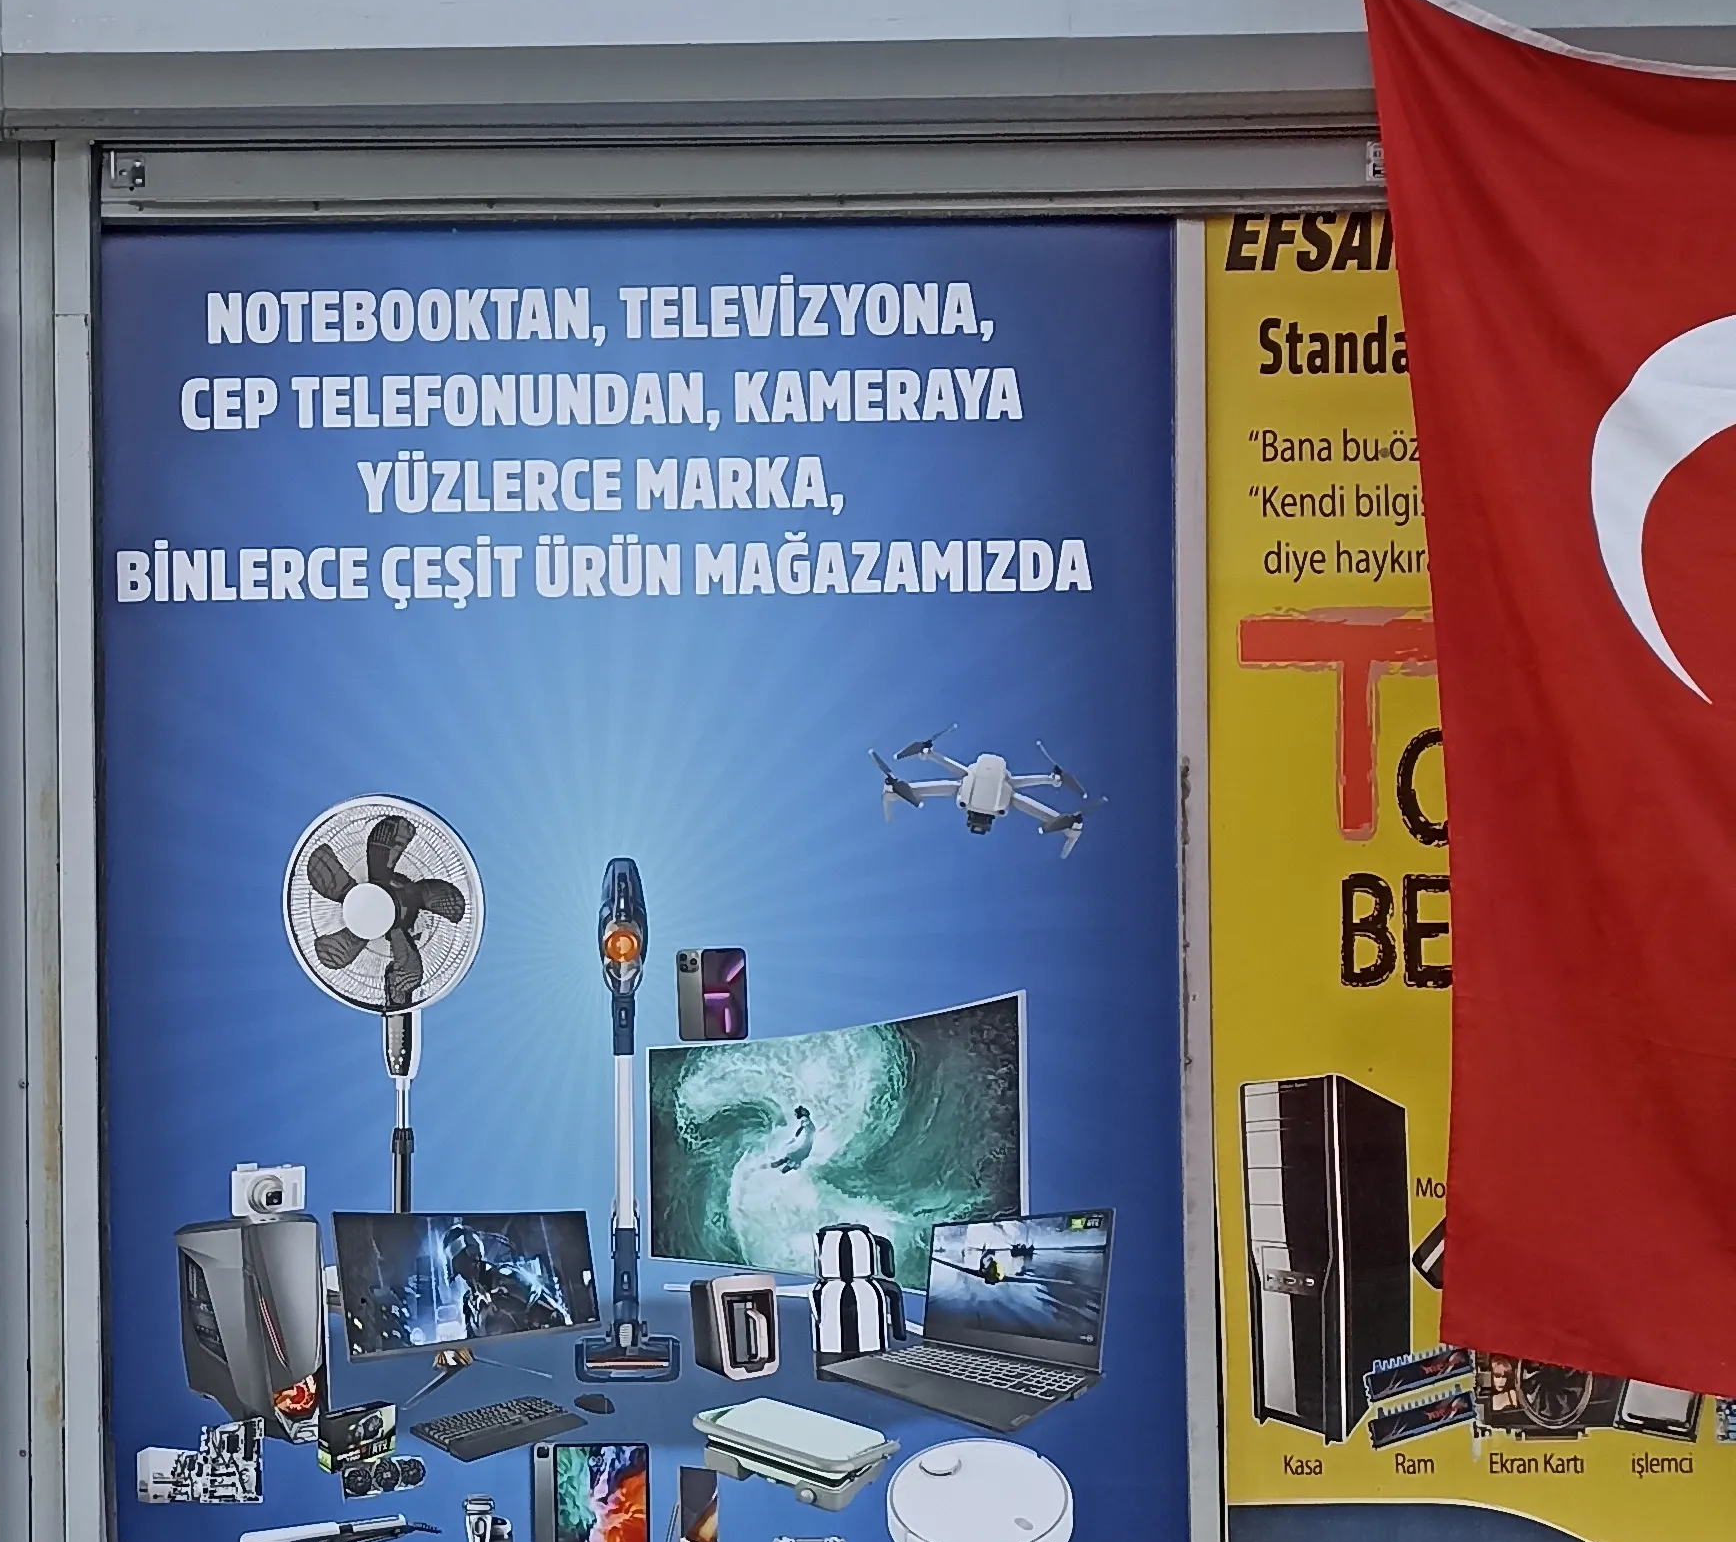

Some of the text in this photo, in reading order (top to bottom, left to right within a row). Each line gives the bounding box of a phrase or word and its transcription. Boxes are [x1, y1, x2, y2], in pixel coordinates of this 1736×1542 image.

[206, 274, 995, 348] NOTEBOOKTAN, TELEVİZYONA,
[180, 367, 1023, 431] CEP TELEFONUNDAN, KAMERAYA
[1343, 428, 1379, 462] bu
[357, 450, 844, 516] YÜZLERCE MARKA,
[1356, 483, 1424, 526] bilgi
[116, 532, 1092, 610] BİNLERCE ÇEŞİT ÜRÜN MAĞAZAMIZDA
[1264, 540, 1326, 582] diye
[1283, 1454, 1323, 1476] Kasa
[1395, 1453, 1435, 1475] Ram
[1489, 1452, 1584, 1475] Ekran Kartı
[1631, 1452, 1694, 1478] işlemci
